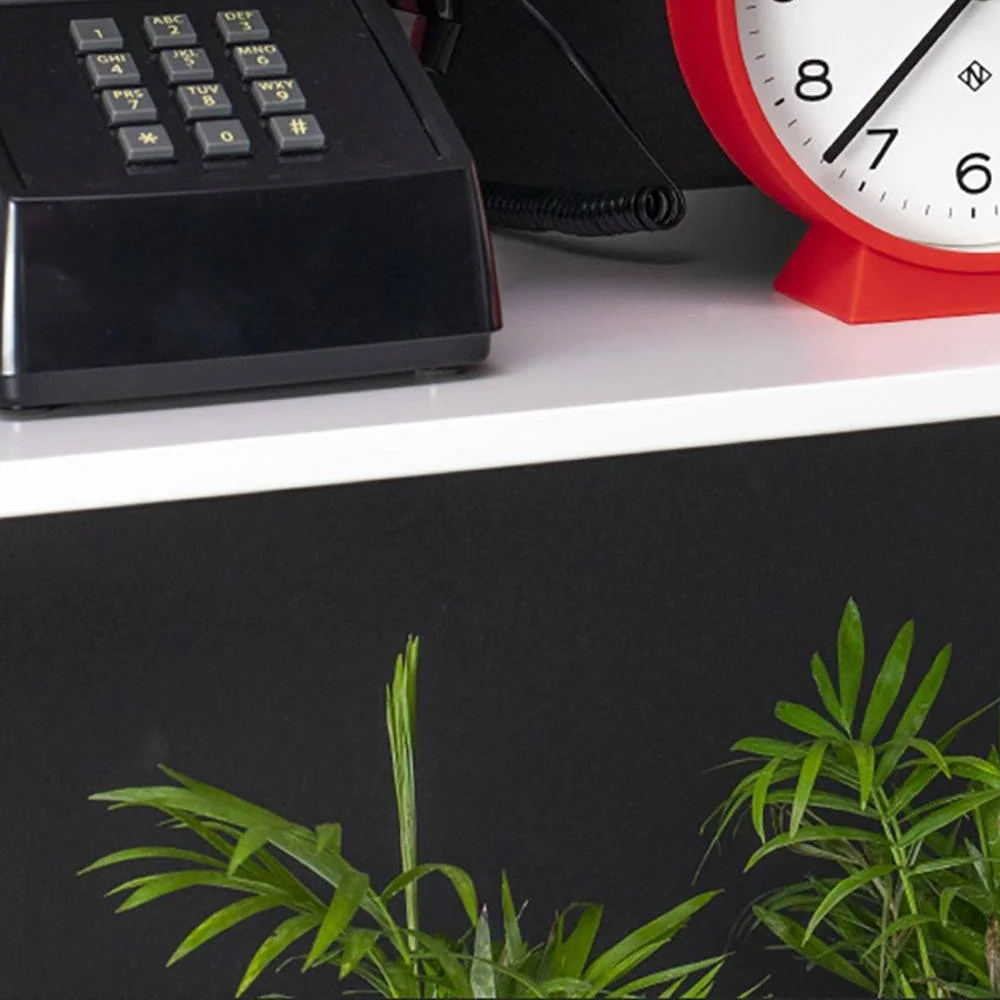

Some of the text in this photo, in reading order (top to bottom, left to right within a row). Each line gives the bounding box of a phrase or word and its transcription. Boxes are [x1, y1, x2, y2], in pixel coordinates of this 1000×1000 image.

[152, 14, 183, 25] ABC
[168, 25, 180, 36] 2
[240, 21, 252, 31] 3
[93, 28, 104, 40] 1
[110, 63, 124, 75] 4
[258, 79, 295, 91] WXY
[794, 59, 833, 102] 8
[112, 88, 144, 100] PRS
[186, 83, 219, 95] TUV
[202, 94, 216, 107] 8
[275, 90, 290, 102] 9
[127, 99, 139, 111] 7
[219, 130, 235, 143] 0
[866, 128, 899, 170] 7
[955, 152, 992, 195] 6
